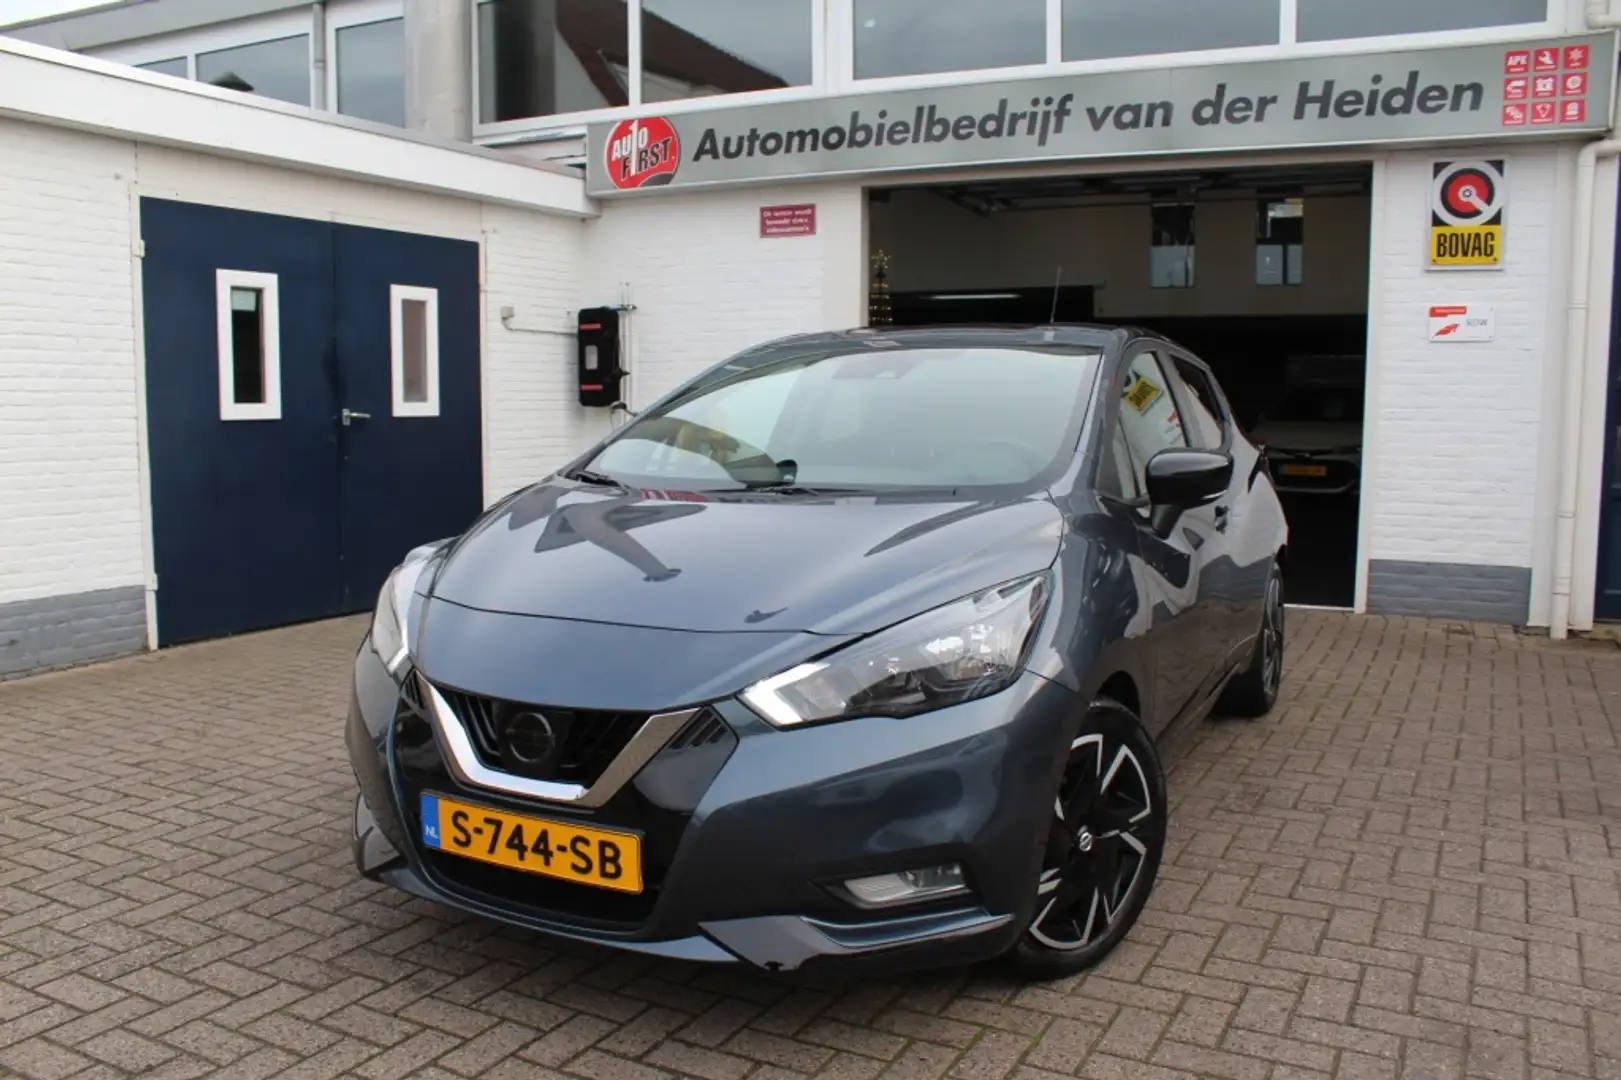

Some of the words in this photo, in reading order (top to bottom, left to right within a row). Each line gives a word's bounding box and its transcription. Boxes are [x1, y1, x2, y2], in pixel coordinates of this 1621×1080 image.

[692, 92, 1074, 162] Automobielbedrijf
[1086, 100, 1174, 132] van
[1192, 83, 1278, 126] der
[1293, 70, 1484, 120] Heiden
[1436, 231, 1496, 258] BOVAG
[425, 824, 438, 839] NL
[451, 810, 623, 880] S-744-SB
